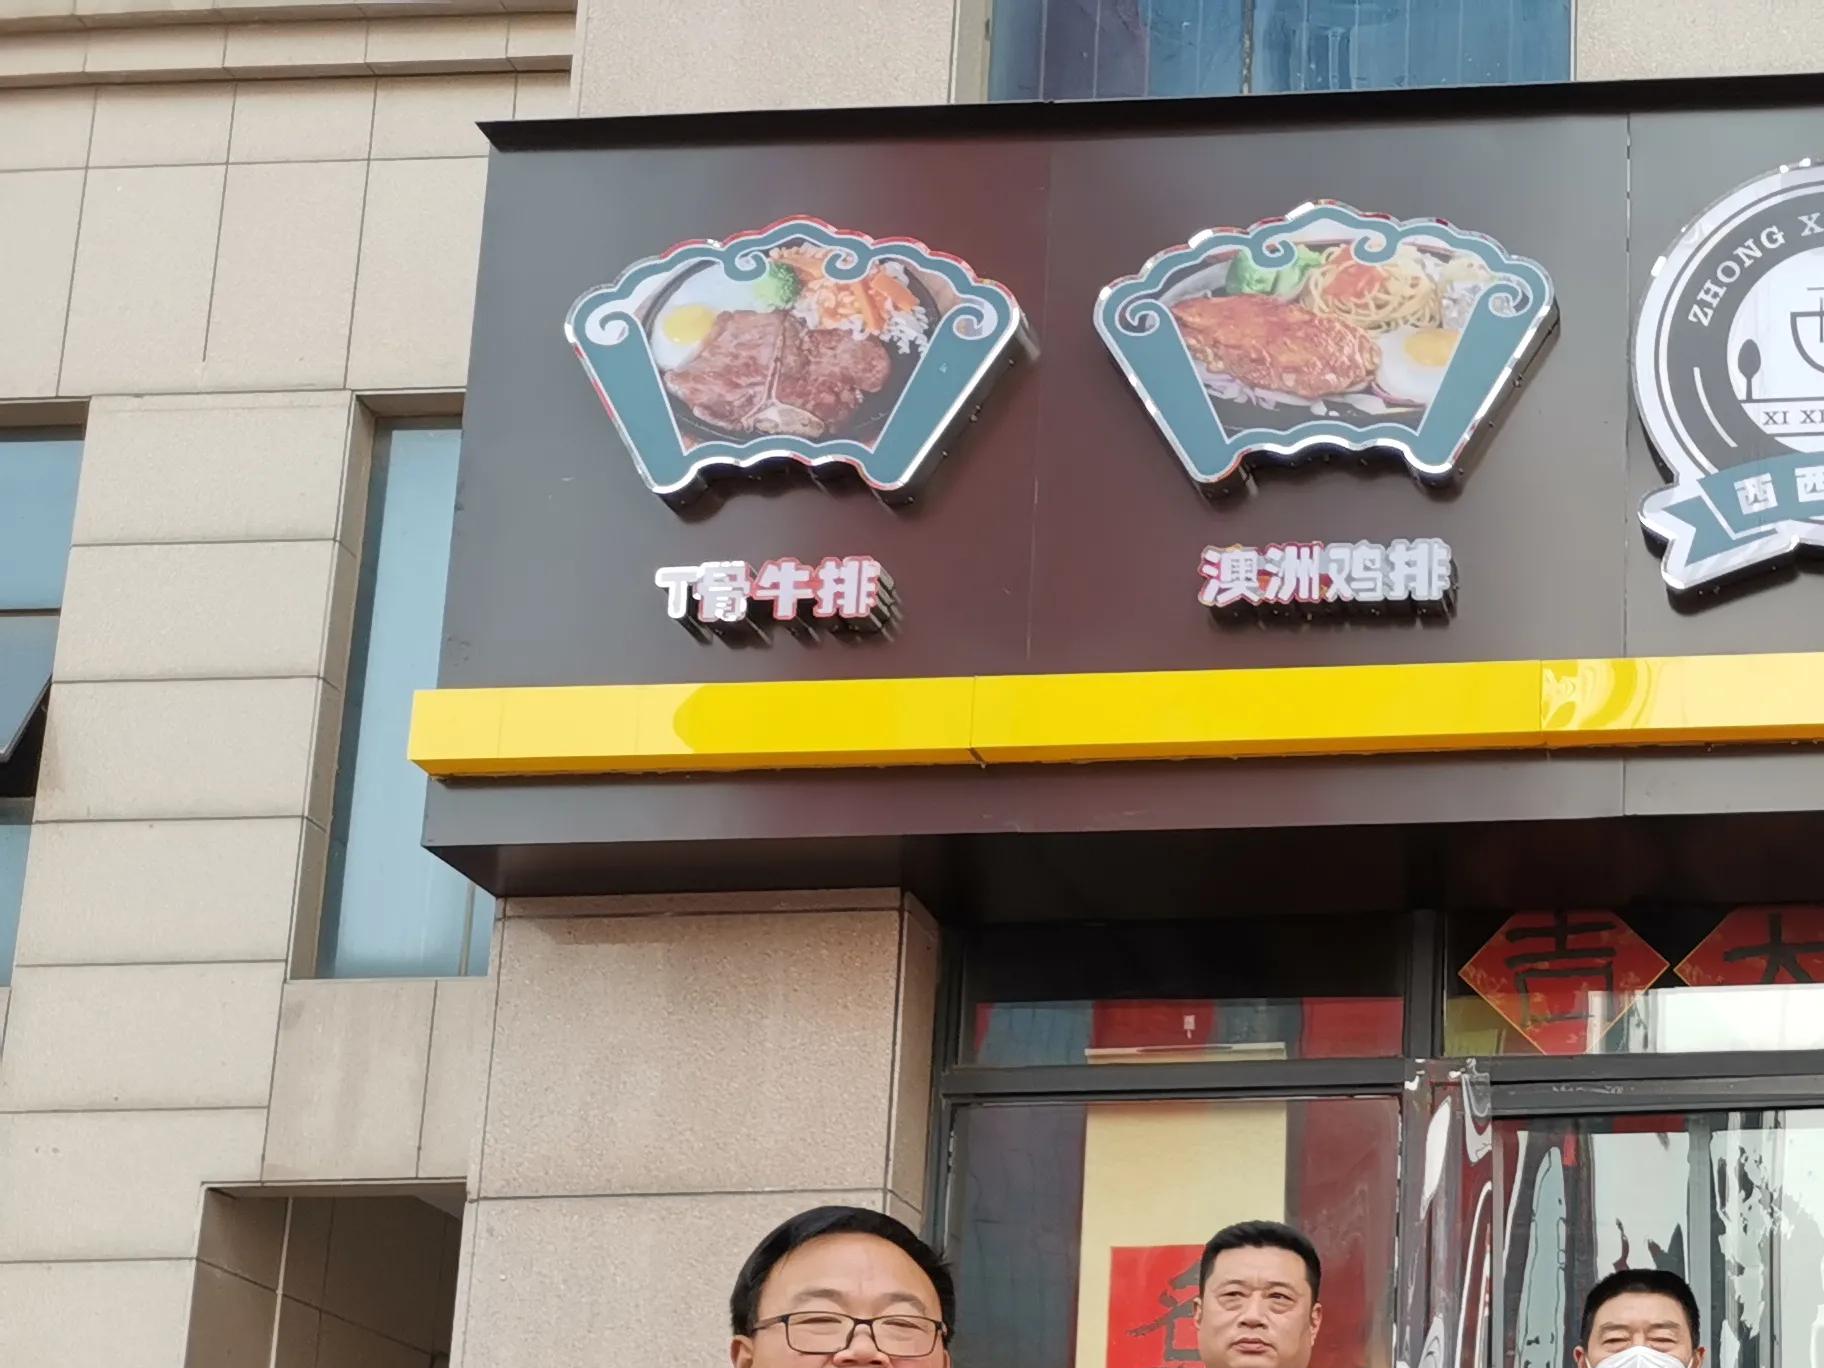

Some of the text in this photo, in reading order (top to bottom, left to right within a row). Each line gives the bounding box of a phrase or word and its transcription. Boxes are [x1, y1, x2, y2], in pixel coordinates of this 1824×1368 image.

[1687, 224, 1787, 327] ZHONG
[1762, 410, 1790, 426] XI
[655, 556, 882, 623] T骨牛排
[1198, 537, 1453, 607] 澳洲鸡排
